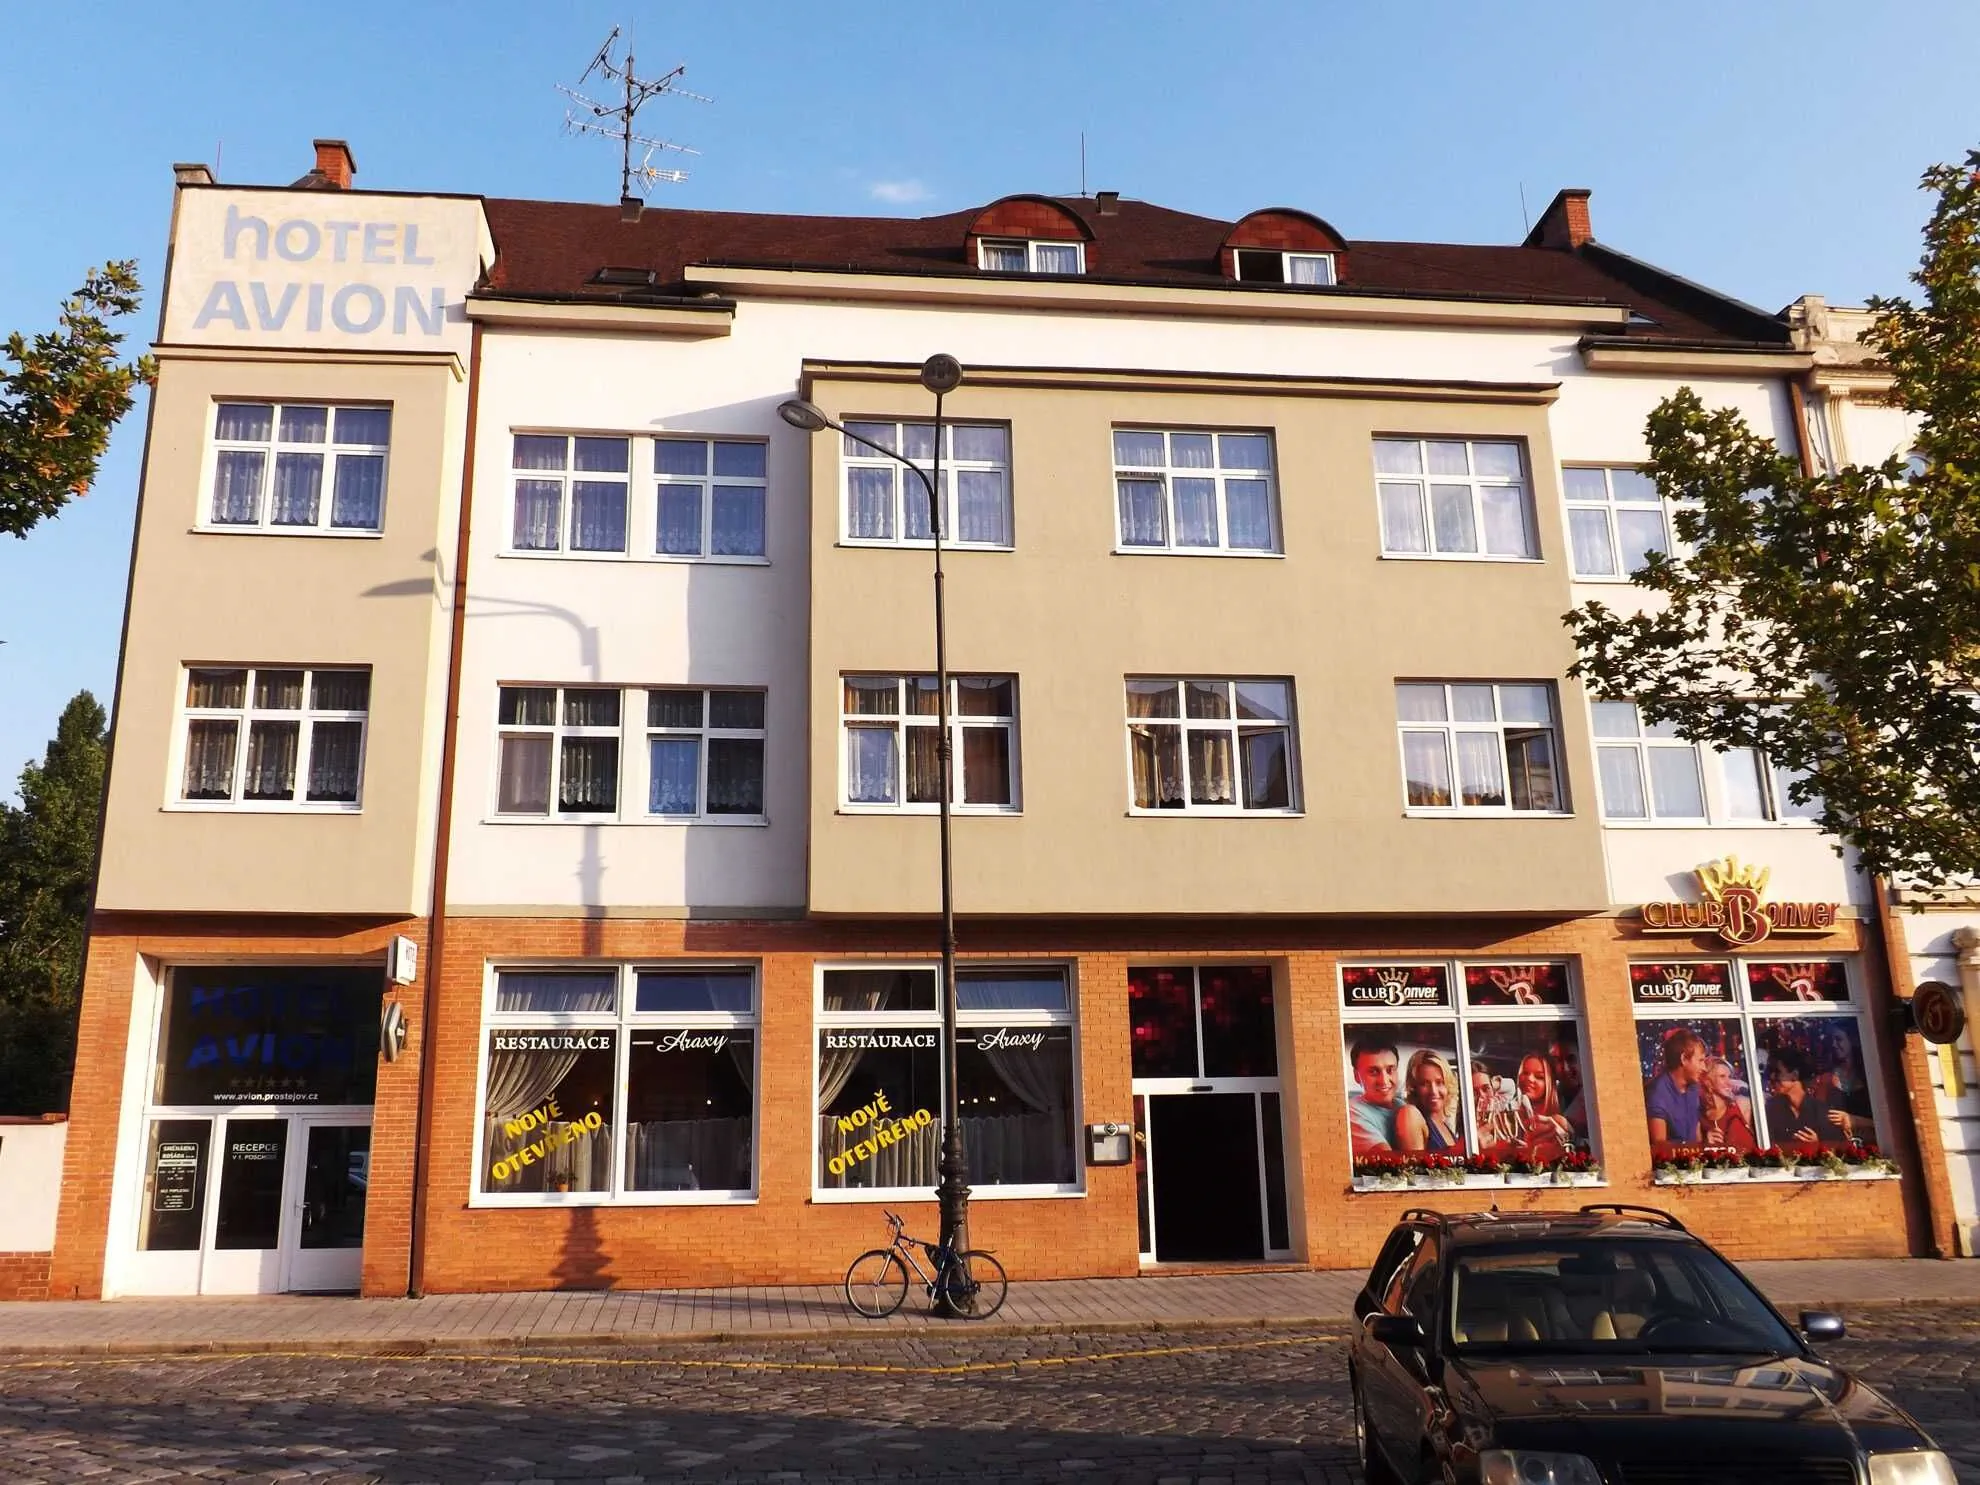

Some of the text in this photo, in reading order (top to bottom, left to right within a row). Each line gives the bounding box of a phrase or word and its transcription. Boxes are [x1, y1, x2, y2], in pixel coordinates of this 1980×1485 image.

[192, 280, 445, 336] AVION
[1644, 901, 1725, 928] CLUB
[1352, 986, 1387, 998] CLUB
[1639, 983, 1673, 996] CLUB
[495, 1036, 610, 1050] RESTAURACE
[656, 1030, 728, 1053] Araxy
[826, 1035, 936, 1049] RESTAURACE
[977, 1028, 1045, 1050] Araxy
[213, 1092, 319, 1102] www.avion.prostejov.cz
[504, 1093, 563, 1140] NOVĚ
[837, 1088, 892, 1135] NOVĚ
[232, 1143, 279, 1152] RECEPCE
[492, 1111, 602, 1180] OTEVŘENO
[828, 1108, 932, 1175] OTEVŘENO
